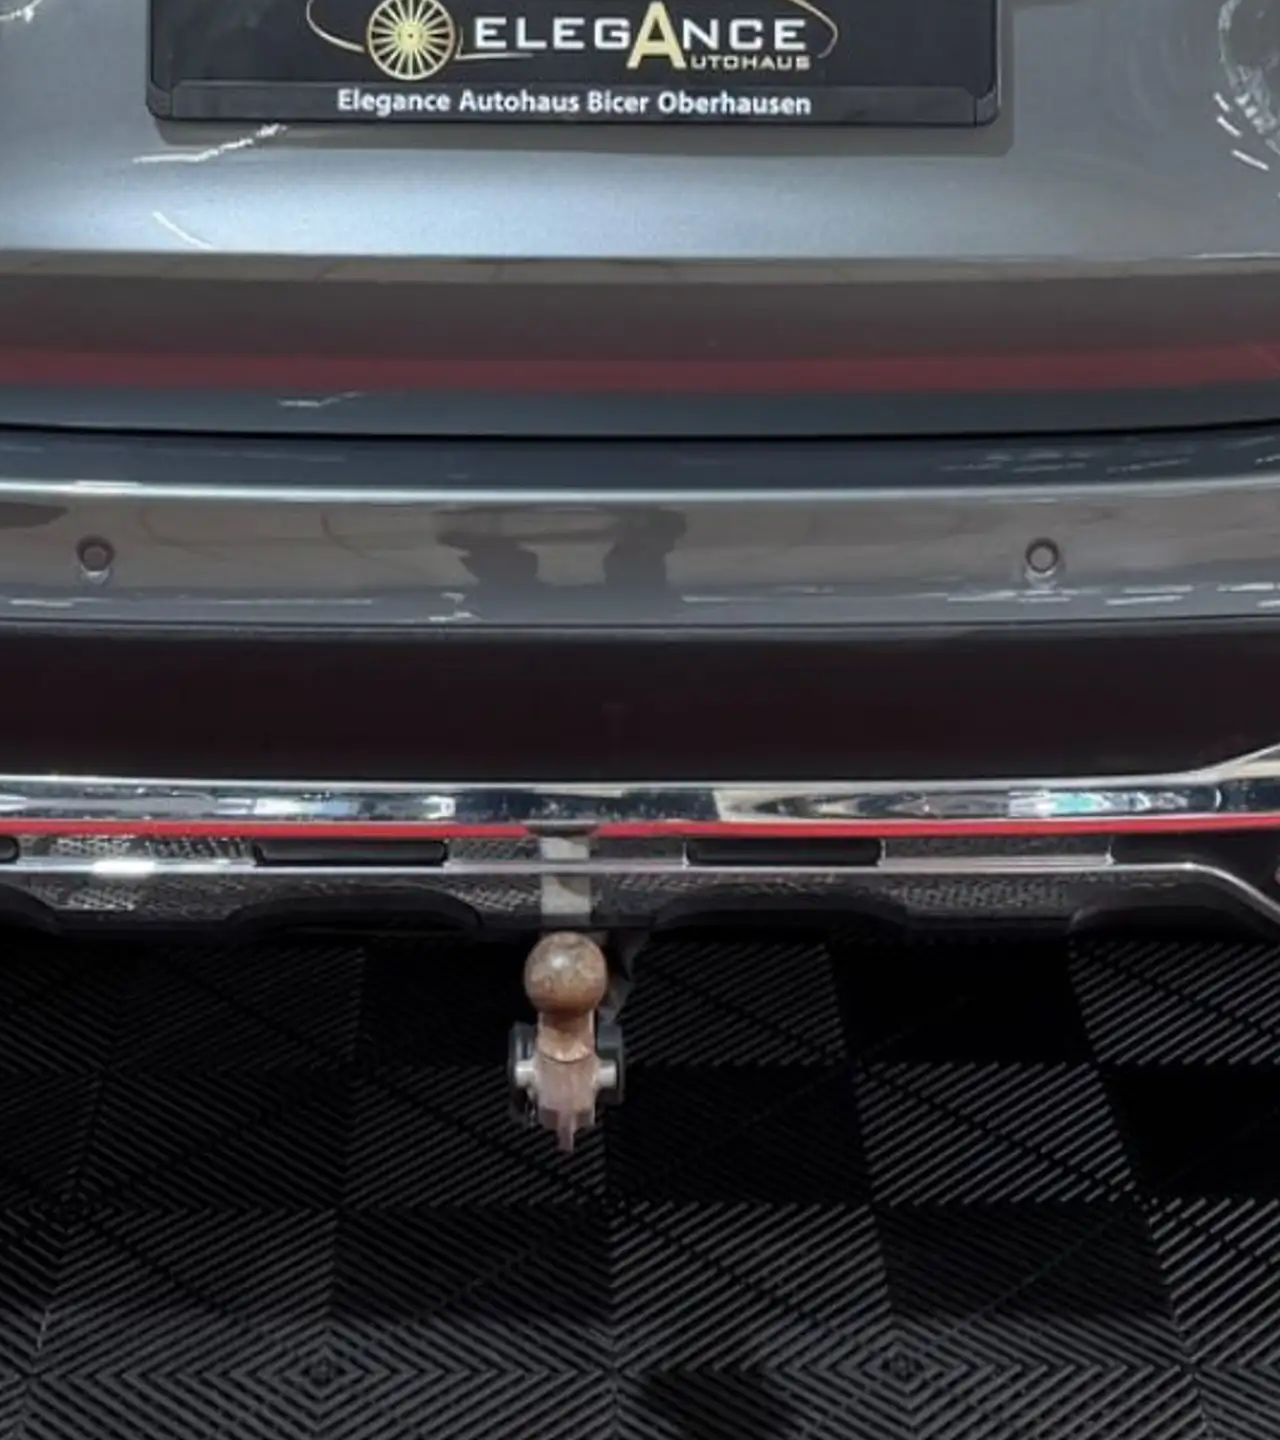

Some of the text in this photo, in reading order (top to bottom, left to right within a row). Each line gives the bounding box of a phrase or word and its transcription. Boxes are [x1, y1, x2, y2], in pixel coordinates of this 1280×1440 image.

[473, 0, 807, 70] ELEGANCE
[337, 89, 812, 116] Elegance Autohaus Bicer Oberhausen
